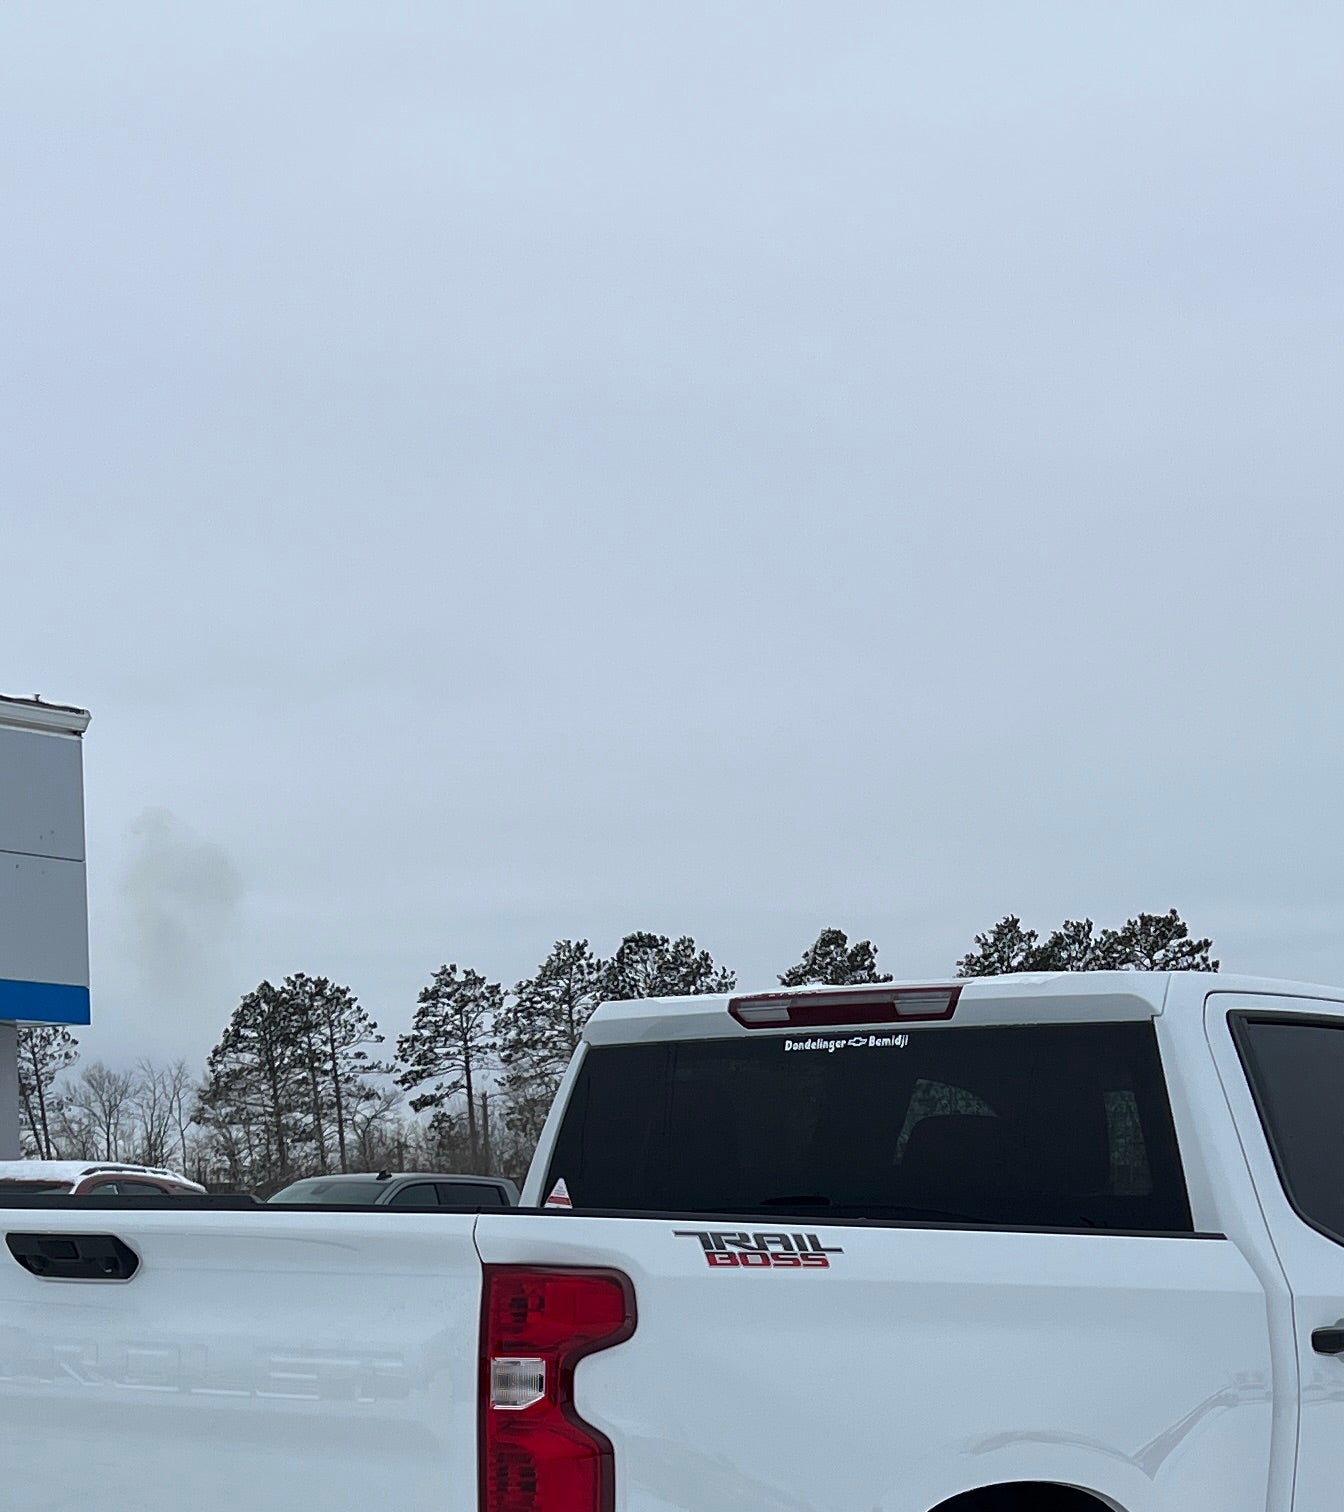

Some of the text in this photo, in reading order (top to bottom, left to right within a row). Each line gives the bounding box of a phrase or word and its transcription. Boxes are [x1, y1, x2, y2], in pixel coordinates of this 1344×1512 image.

[784, 1034, 909, 1052] Dondelinger Bemidji
[672, 1230, 844, 1254] TRAIL
[705, 1251, 830, 1268] BOSS
